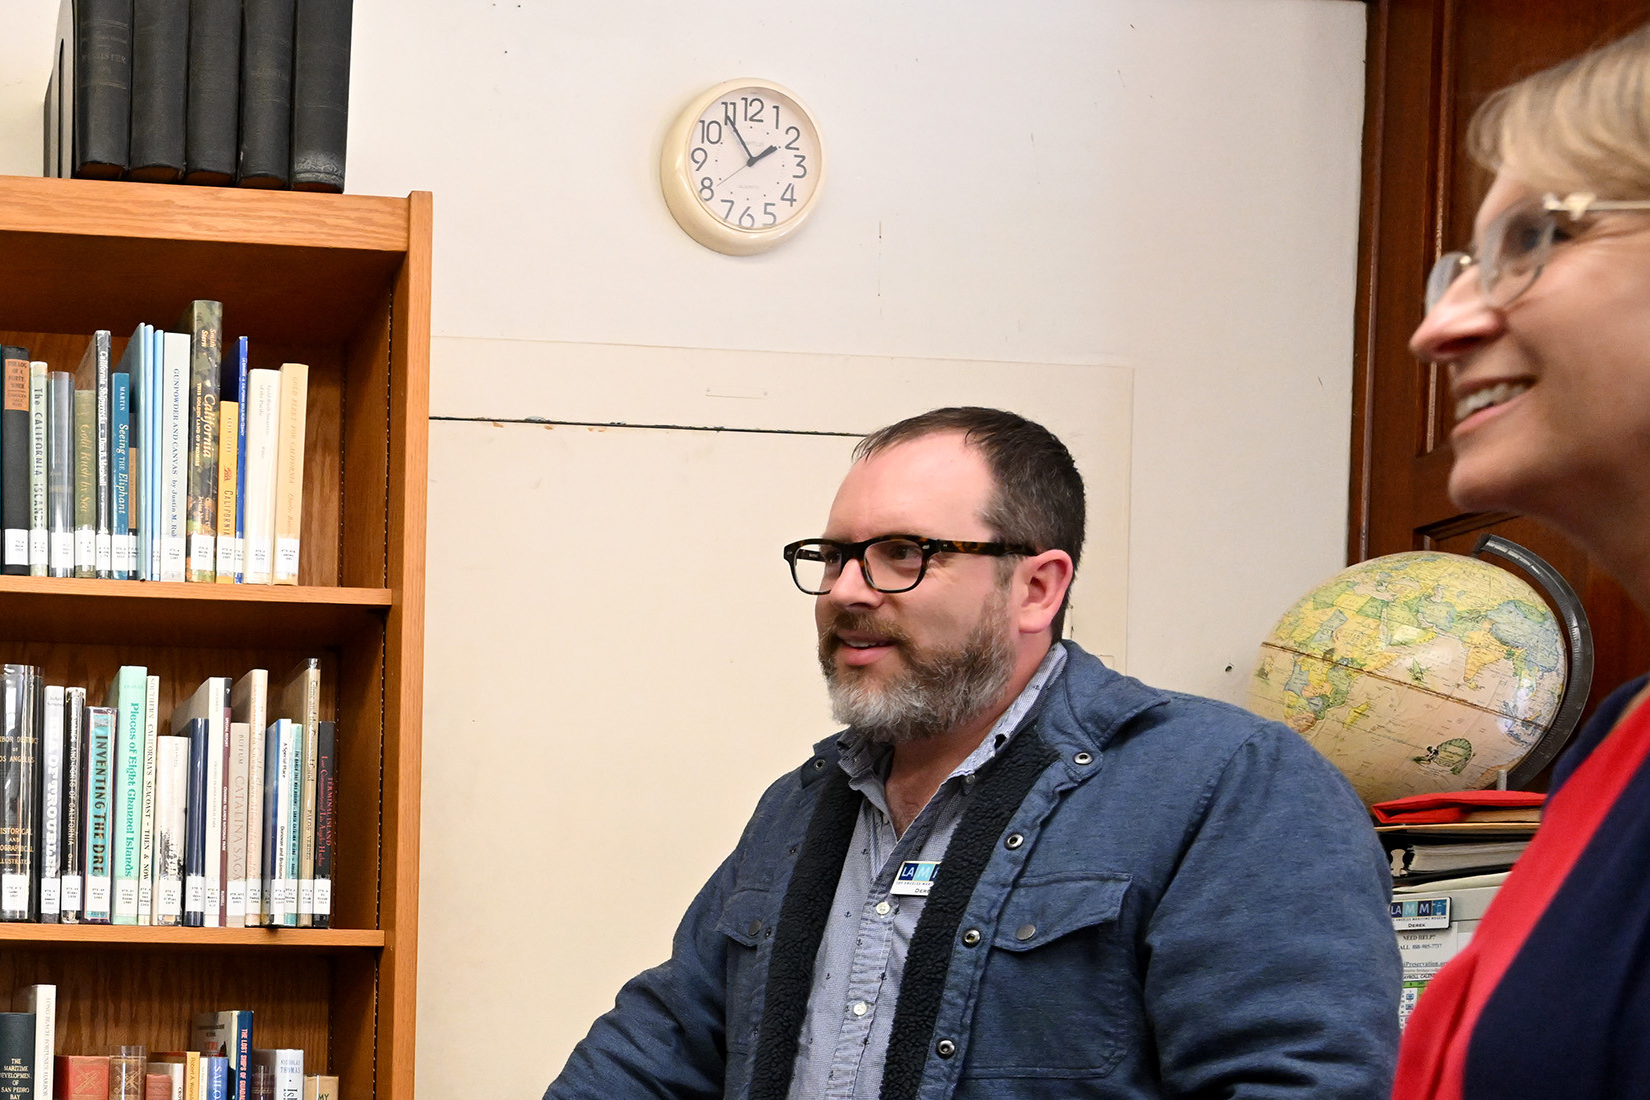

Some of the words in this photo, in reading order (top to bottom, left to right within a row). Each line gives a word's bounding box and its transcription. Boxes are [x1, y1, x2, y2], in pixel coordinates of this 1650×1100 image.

[721, 102, 736, 126] 11
[741, 98, 764, 122] 12
[773, 106, 779, 129] 1
[699, 120, 722, 144] 10
[785, 126, 800, 150] 2
[691, 148, 708, 171] 9
[793, 155, 807, 178] 3
[699, 177, 714, 201] 8
[781, 183, 797, 207] 4
[721, 199, 735, 222] 7
[738, 206, 755, 228] 6
[763, 203, 777, 226] 5
[203, 394, 216, 459] California
[129, 703, 139, 740] Pieces
[129, 742, 138, 753] of
[94, 735, 108, 810] INVENTING
[127, 755, 137, 787] Eight
[125, 789, 136, 835] Channel
[235, 776, 245, 838] CATALINA
[93, 812, 107, 839] THE
[125, 837, 135, 877] Islands
[233, 841, 244, 881] SAGA
